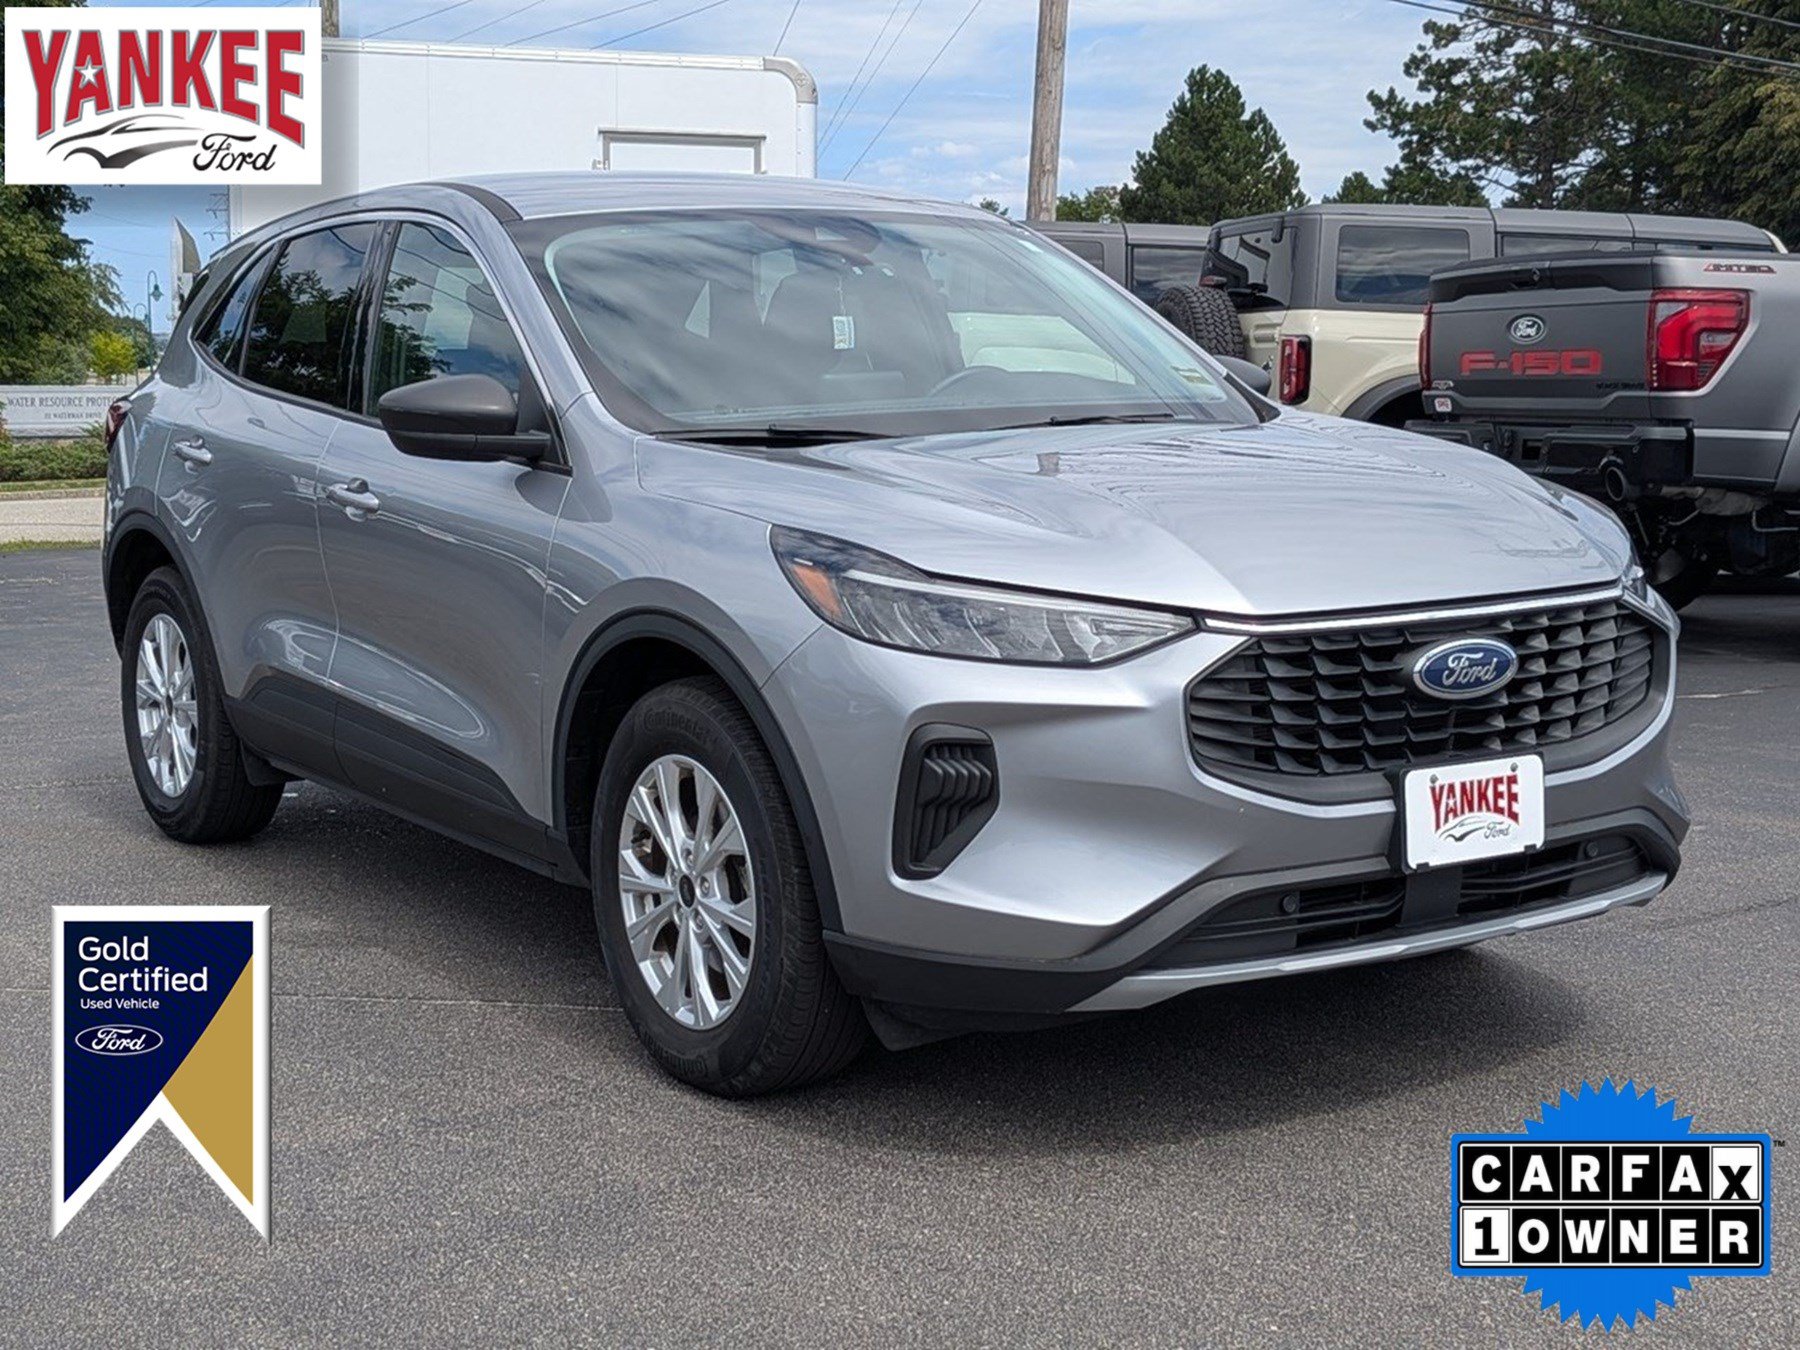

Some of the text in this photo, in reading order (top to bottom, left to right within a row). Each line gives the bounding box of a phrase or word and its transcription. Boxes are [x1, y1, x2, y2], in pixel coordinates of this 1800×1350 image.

[1516, 319, 1539, 337] Ford
[1460, 351, 1602, 376] F-150
[7, 396, 36, 408] WATER
[39, 396, 83, 408] RESOURCE
[1442, 652, 1498, 686] Ford
[1429, 773, 1520, 834] YANKEE
[1484, 821, 1510, 839] Ford
